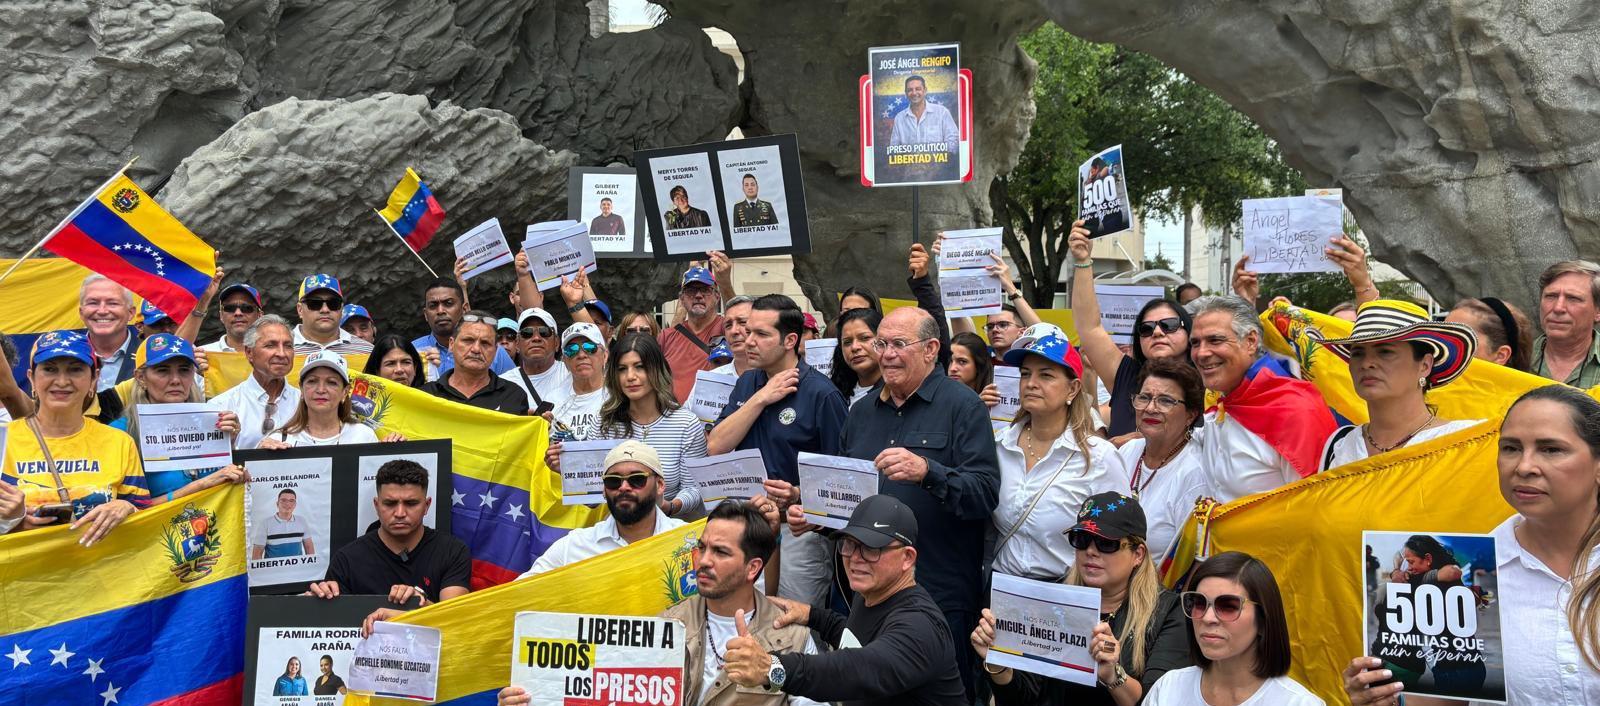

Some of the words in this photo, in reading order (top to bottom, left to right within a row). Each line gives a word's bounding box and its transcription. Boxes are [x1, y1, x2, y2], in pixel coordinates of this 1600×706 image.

[879, 58, 896, 70] JOSÉ
[897, 57, 920, 69] ÁNGEL
[921, 56, 951, 67] RENGIFO
[886, 144, 912, 155] ¡PRESO
[889, 154, 931, 165] LIBERTAD
[932, 153, 948, 162] YA!
[1083, 175, 1117, 209] 500
[1081, 202, 1108, 217] FAMILIAS
[1108, 198, 1121, 208] QUE
[1251, 208, 1290, 234] Angel
[733, 226, 765, 234] LIBERTAD
[543, 258, 559, 267] PABLO
[1284, 258, 1308, 271] YA
[570, 413, 593, 427] ALAS
[145, 435, 160, 445] STO.
[161, 434, 177, 444] LUIS
[178, 432, 205, 443] OVIEDO
[206, 429, 224, 441] PIÑA
[576, 427, 585, 436] DE
[280, 473, 320, 481] BELANDRIA
[817, 488, 830, 498] LUIS
[251, 558, 299, 569] LIBERTAD
[300, 556, 317, 564] YA!
[1386, 582, 1478, 638] 500
[276, 630, 323, 639] FAMILIA
[325, 629, 364, 639] RODRÍ
[577, 617, 655, 648] LIBEREN
[661, 622, 674, 649] A
[995, 618, 1028, 636] MIGUEL
[1029, 624, 1057, 642] ÁNGEL
[1059, 631, 1087, 649] PLAZA
[311, 640, 355, 651] ARAÑA.
[1381, 632, 1450, 649] FAMILIAS
[1452, 636, 1485, 652] QUE
[527, 641, 590, 671] TODOS
[1416, 649, 1488, 664] esperan
[354, 656, 379, 668] MICHELLE
[403, 661, 431, 673] UZCATEGUI
[564, 676, 592, 697] LOS
[595, 672, 676, 706] PRESOS
